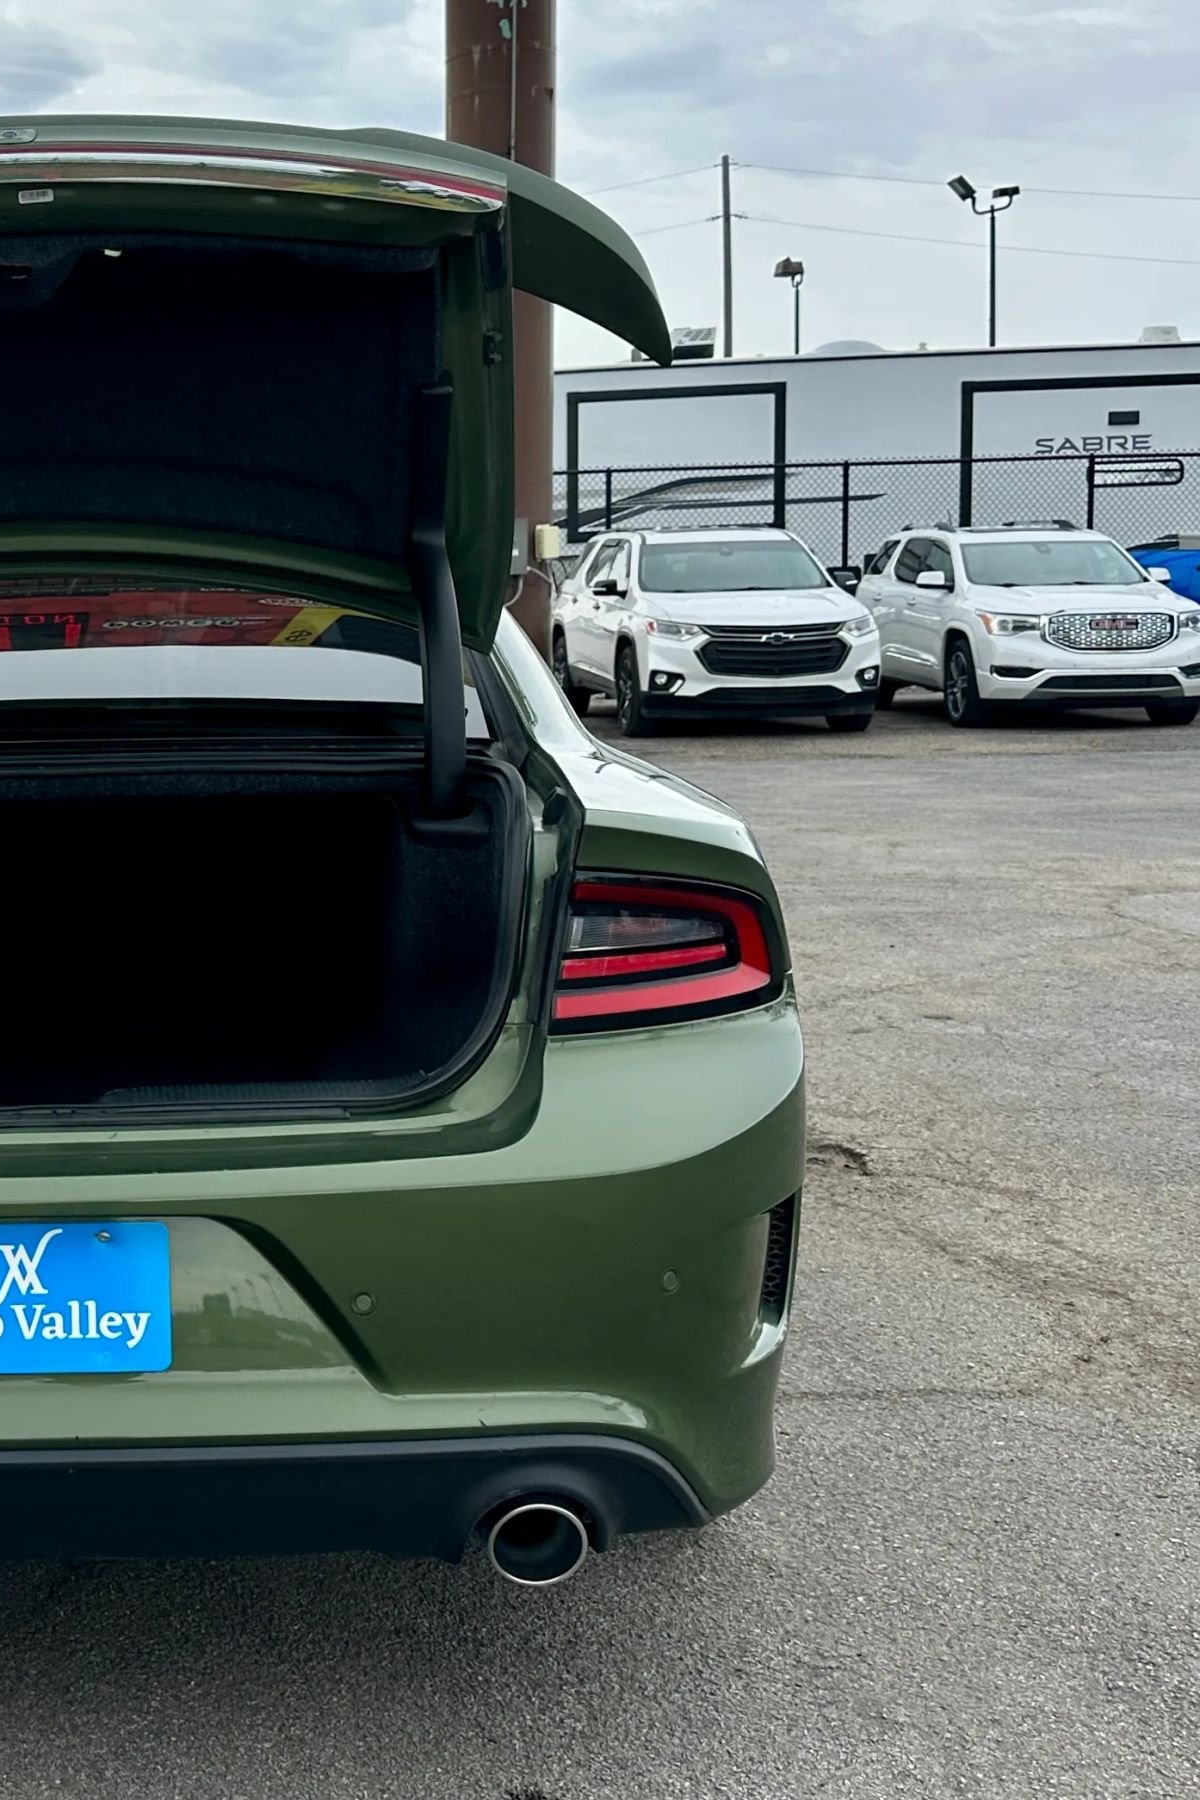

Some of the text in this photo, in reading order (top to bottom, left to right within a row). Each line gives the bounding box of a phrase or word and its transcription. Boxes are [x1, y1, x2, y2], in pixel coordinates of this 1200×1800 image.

[1035, 434, 1152, 454] SABRE
[1090, 619, 1138, 630] GMC
[11, 1300, 151, 1349] Valley
